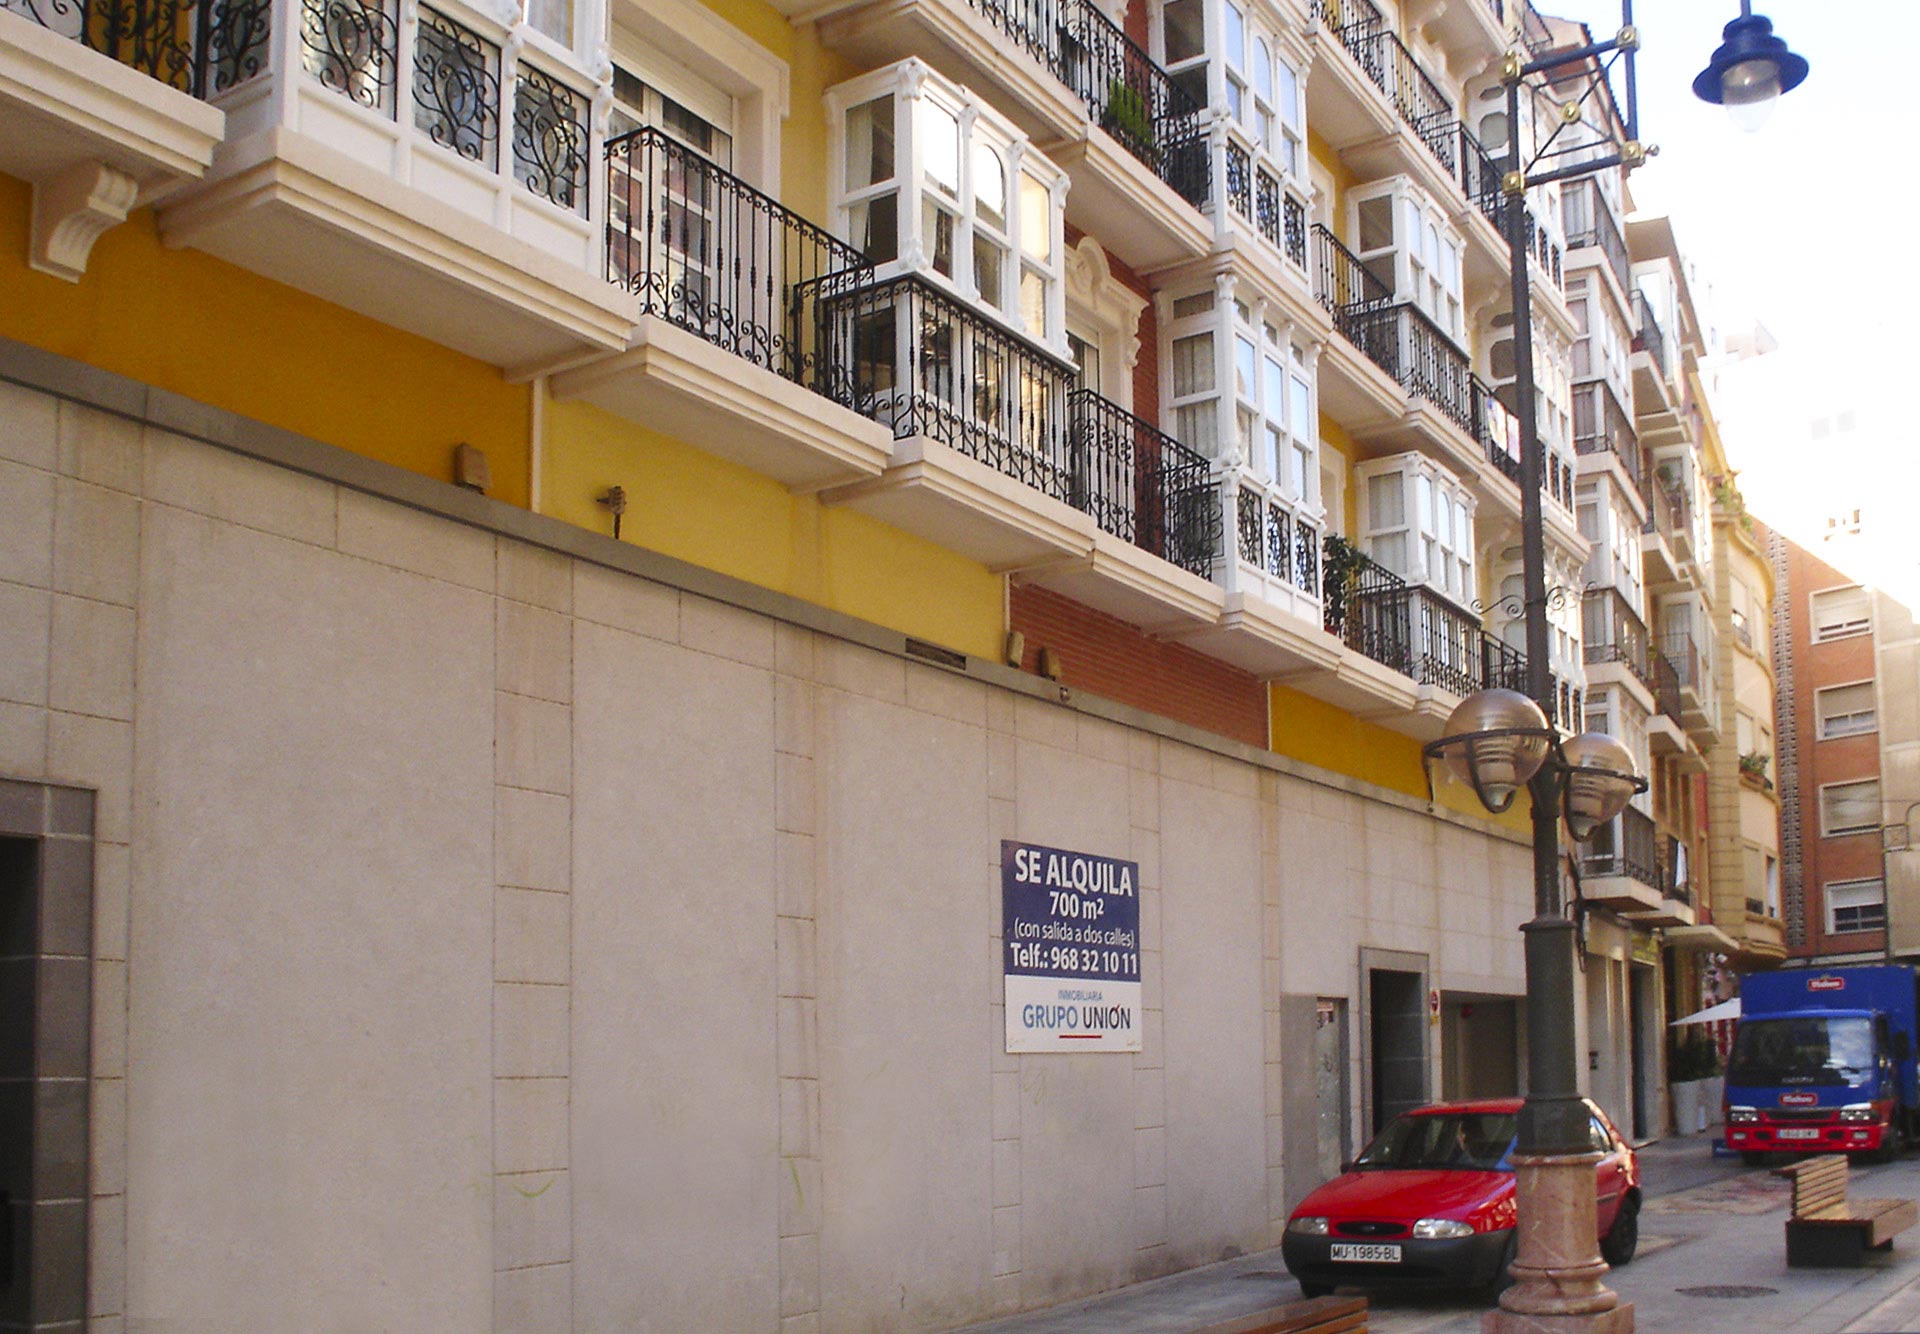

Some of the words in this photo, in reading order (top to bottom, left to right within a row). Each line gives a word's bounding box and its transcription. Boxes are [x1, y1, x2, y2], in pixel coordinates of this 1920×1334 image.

[1015, 848, 1042, 884] SE
[1045, 854, 1133, 897] ALQUILA
[1049, 891, 1079, 918] 700
[1014, 917, 1040, 939] (con
[1042, 921, 1073, 941] salida
[1075, 928, 1082, 942] a
[1083, 924, 1103, 944] dos
[1104, 928, 1135, 949] calles)
[1010, 942, 1048, 969] Telf.:
[1050, 947, 1078, 970] 968
[1081, 949, 1099, 972] 32
[1102, 951, 1119, 974] 10
[1122, 953, 1137, 975] 11
[1058, 990, 1103, 1001] INMOBILIARIA
[1023, 1004, 1078, 1029] GRUPO
[1083, 1004, 1131, 1030] UNIÓN
